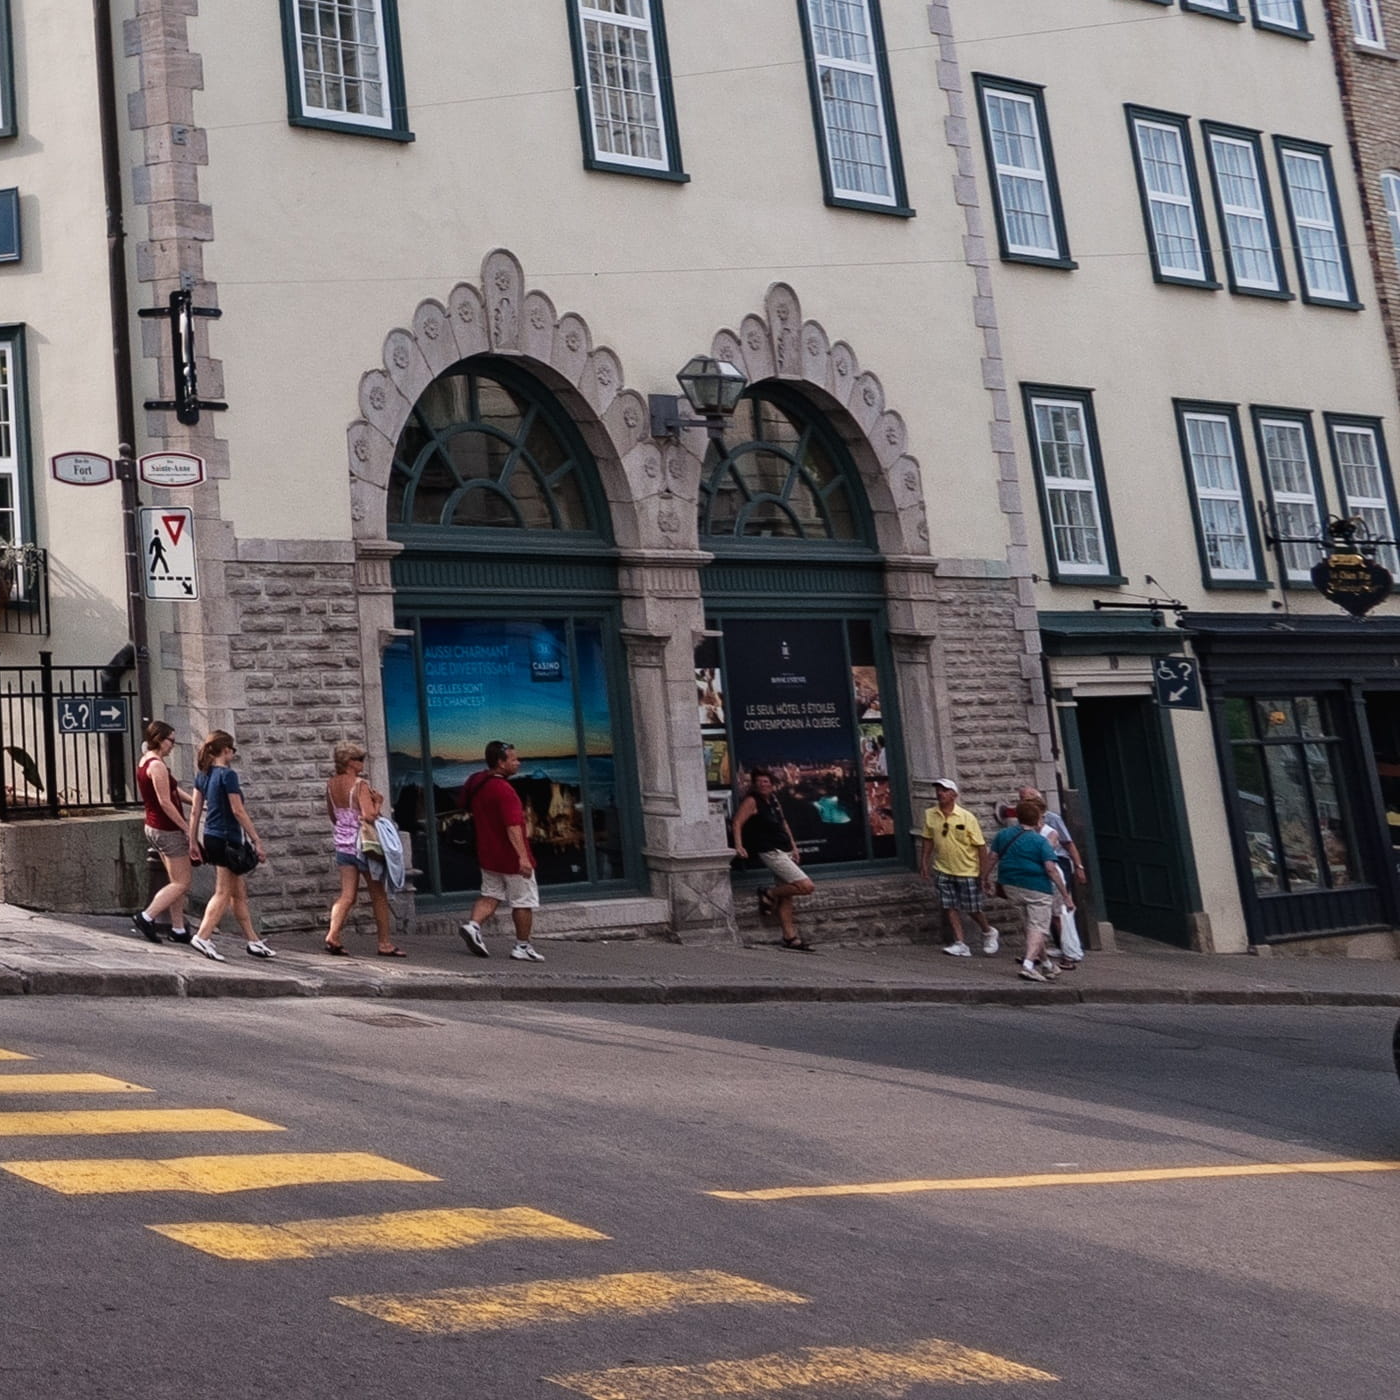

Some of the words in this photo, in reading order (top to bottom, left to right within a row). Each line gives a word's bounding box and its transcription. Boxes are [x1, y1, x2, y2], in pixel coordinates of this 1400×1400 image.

[73, 465, 92, 475] Fort
[151, 464, 190, 472] Sainte-Anne
[425, 645, 453, 658] AUSSI
[454, 645, 510, 658] CHARMANT
[426, 662, 448, 676] QUE
[449, 661, 516, 675] DIVERTISSANT
[532, 661, 561, 671] CASINO
[426, 683, 463, 694] QUELLES
[463, 683, 484, 693] SONT
[427, 696, 442, 707] LES
[746, 704, 756, 716] LE
[756, 704, 776, 715] SEUL
[776, 701, 800, 715] HÔTEL
[743, 718, 805, 731] CONTEMPORAIN
[811, 716, 841, 729] QUÉBEC
